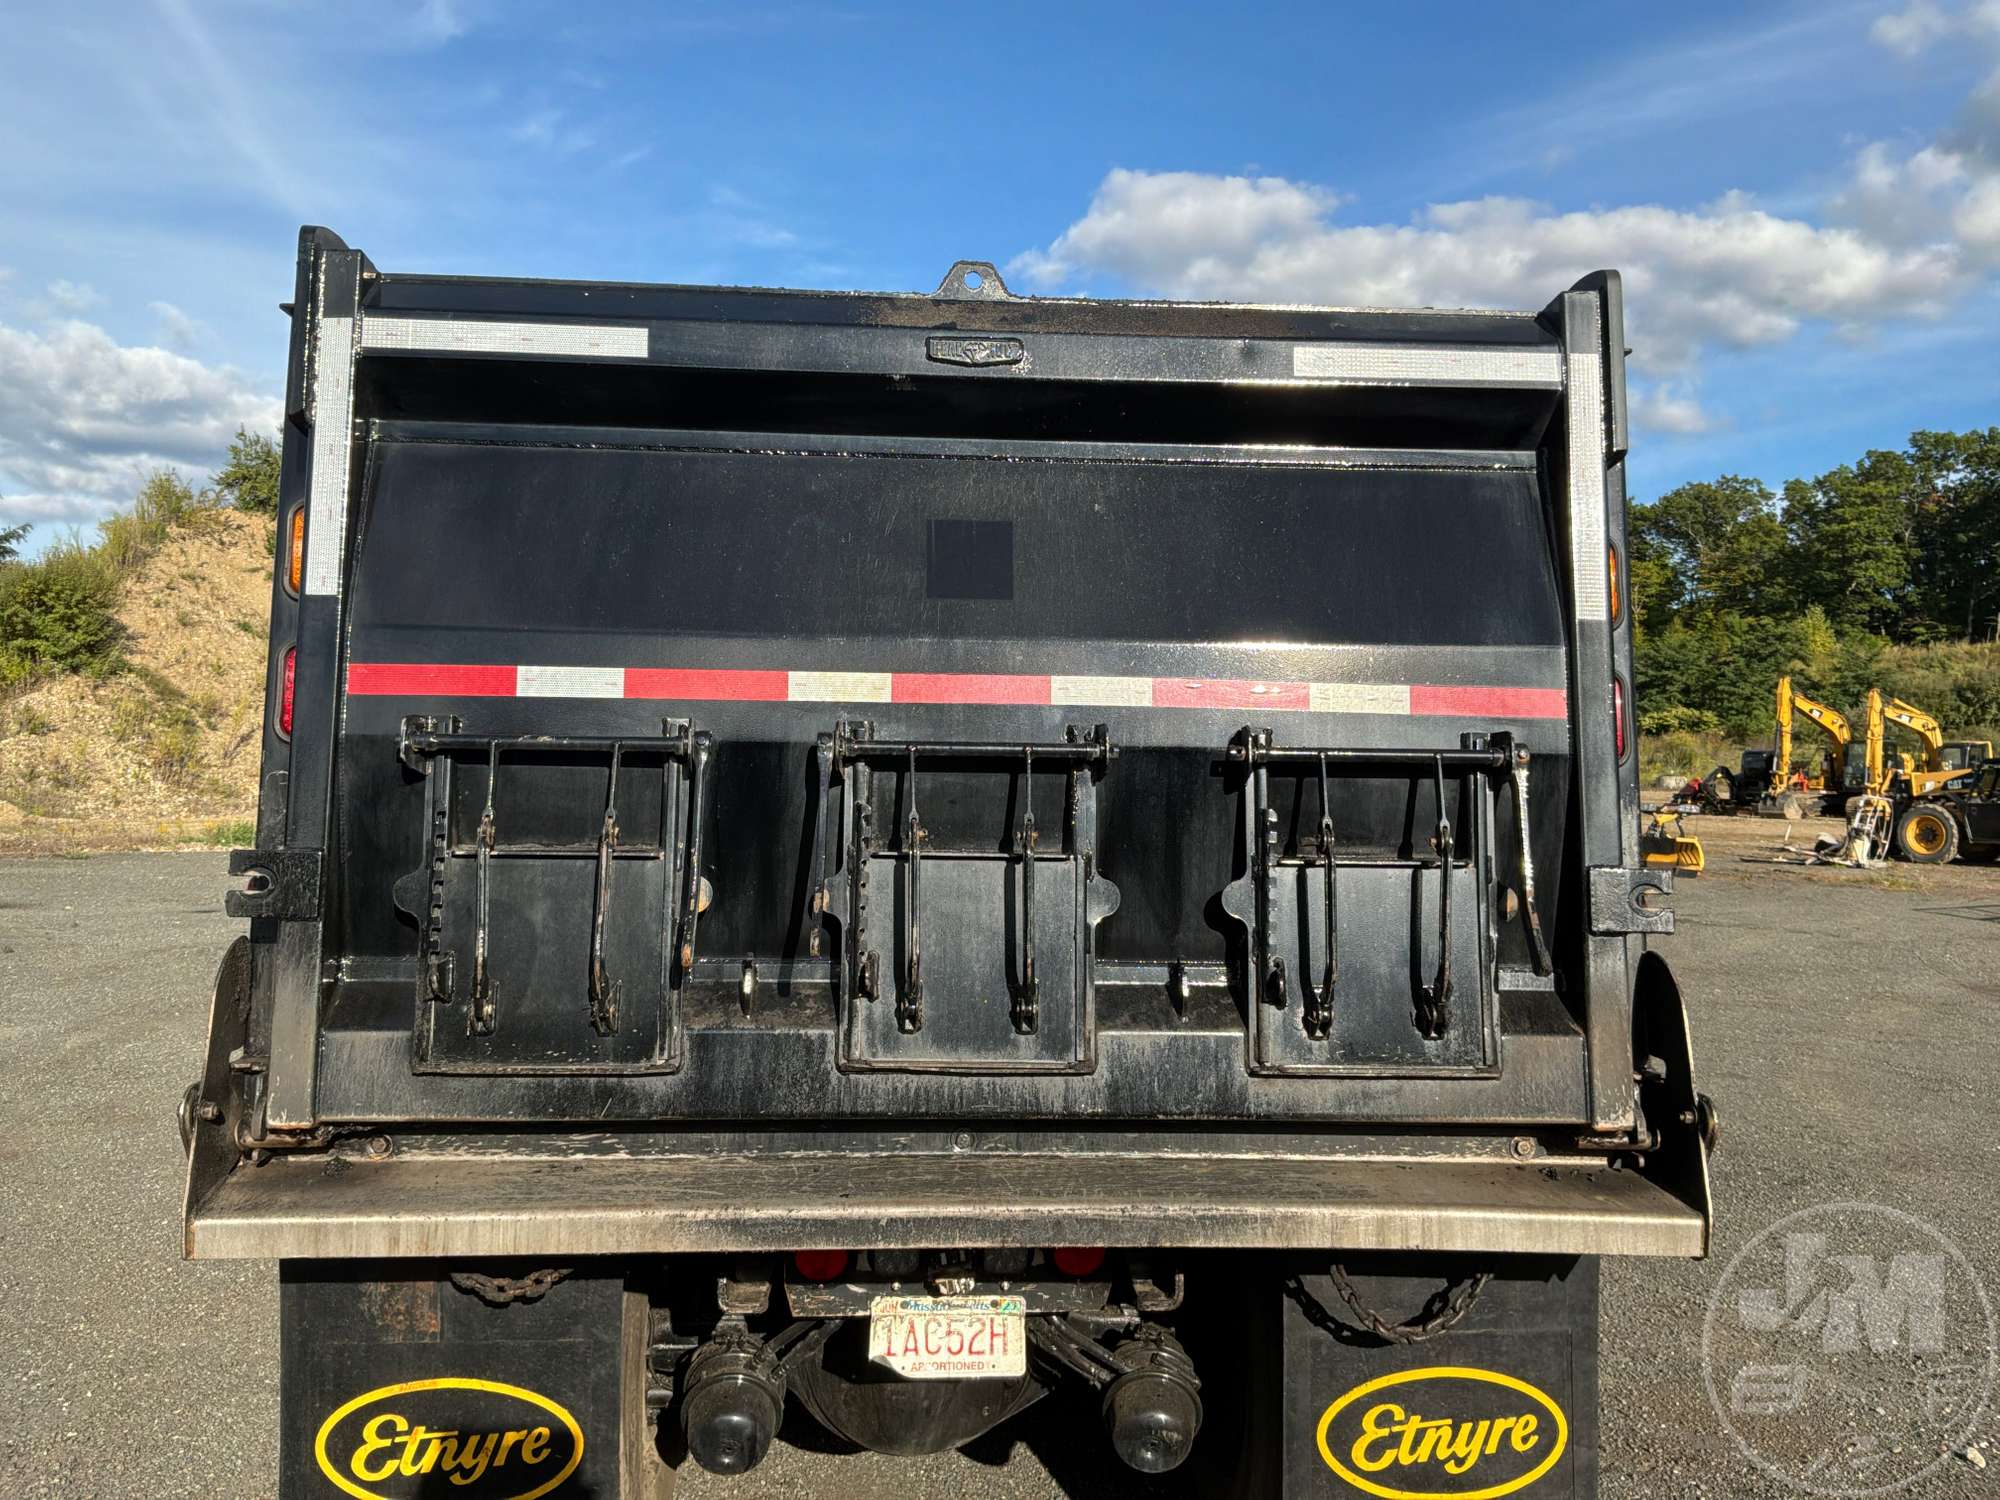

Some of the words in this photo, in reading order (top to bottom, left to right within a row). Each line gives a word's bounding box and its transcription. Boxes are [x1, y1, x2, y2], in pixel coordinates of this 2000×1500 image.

[883, 1316, 1008, 1357] 1AC52H
[911, 1361, 985, 1372] APORTIONED
[351, 1414, 551, 1486] Etnyre
[1351, 1403, 1540, 1475] Etnyre
